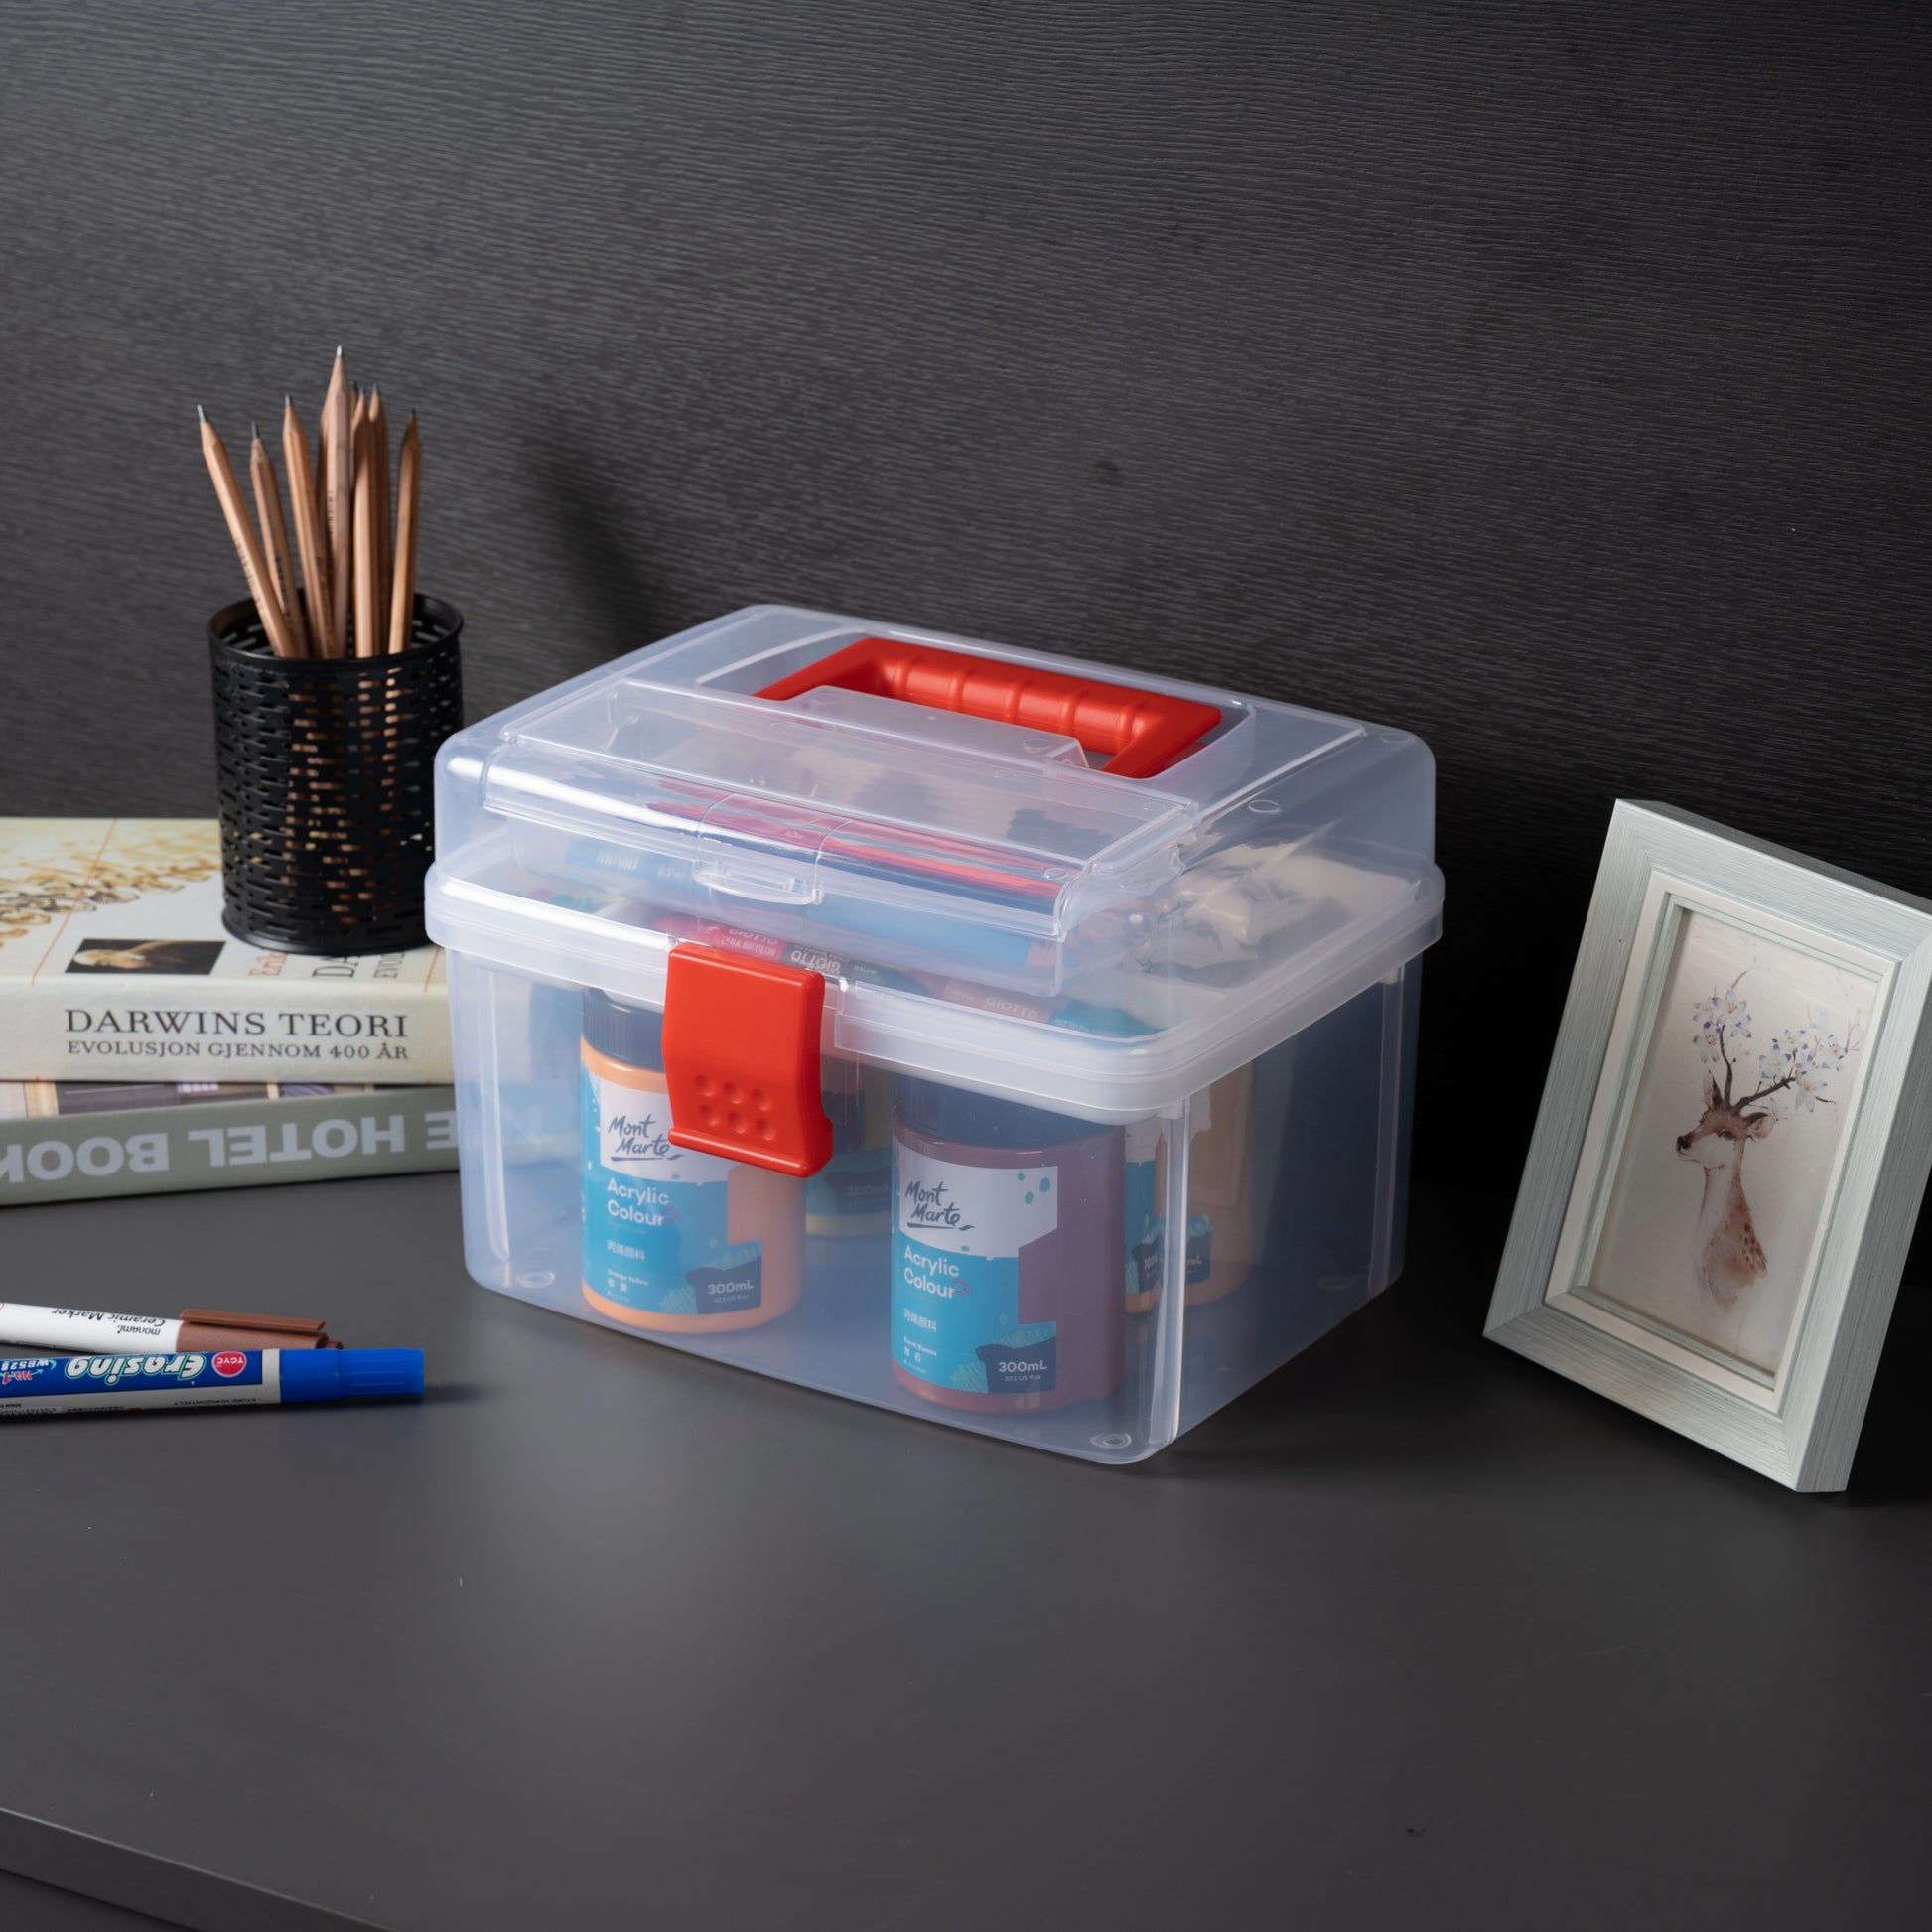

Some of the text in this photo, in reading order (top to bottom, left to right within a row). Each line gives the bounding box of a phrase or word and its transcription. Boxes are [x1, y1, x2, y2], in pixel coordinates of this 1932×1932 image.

[729, 928, 779, 945] GIOTTO
[790, 949, 841, 973] GIOTTO
[986, 996, 1039, 1020] GIOTTO
[65, 1009, 409, 1037] DARWINS TEORI
[68, 1040, 409, 1060] EVOLUSJON GJENNOM 400 ÅR
[608, 1113, 657, 1138] Mont
[188, 1113, 405, 1167] HOTEL
[615, 1133, 670, 1157] Marte
[607, 1178, 670, 1206] Acrylic
[905, 1181, 949, 1204] Mont
[607, 1199, 664, 1227] Colour
[910, 1202, 961, 1226] Marte
[904, 1245, 960, 1277] Acrylic
[707, 1279, 755, 1295] 300mL
[904, 1267, 956, 1299] Colour
[50, 1308, 166, 1327] Ceramic Marker
[65, 1354, 207, 1385] Erasing
[998, 1359, 1048, 1373] 300mL
